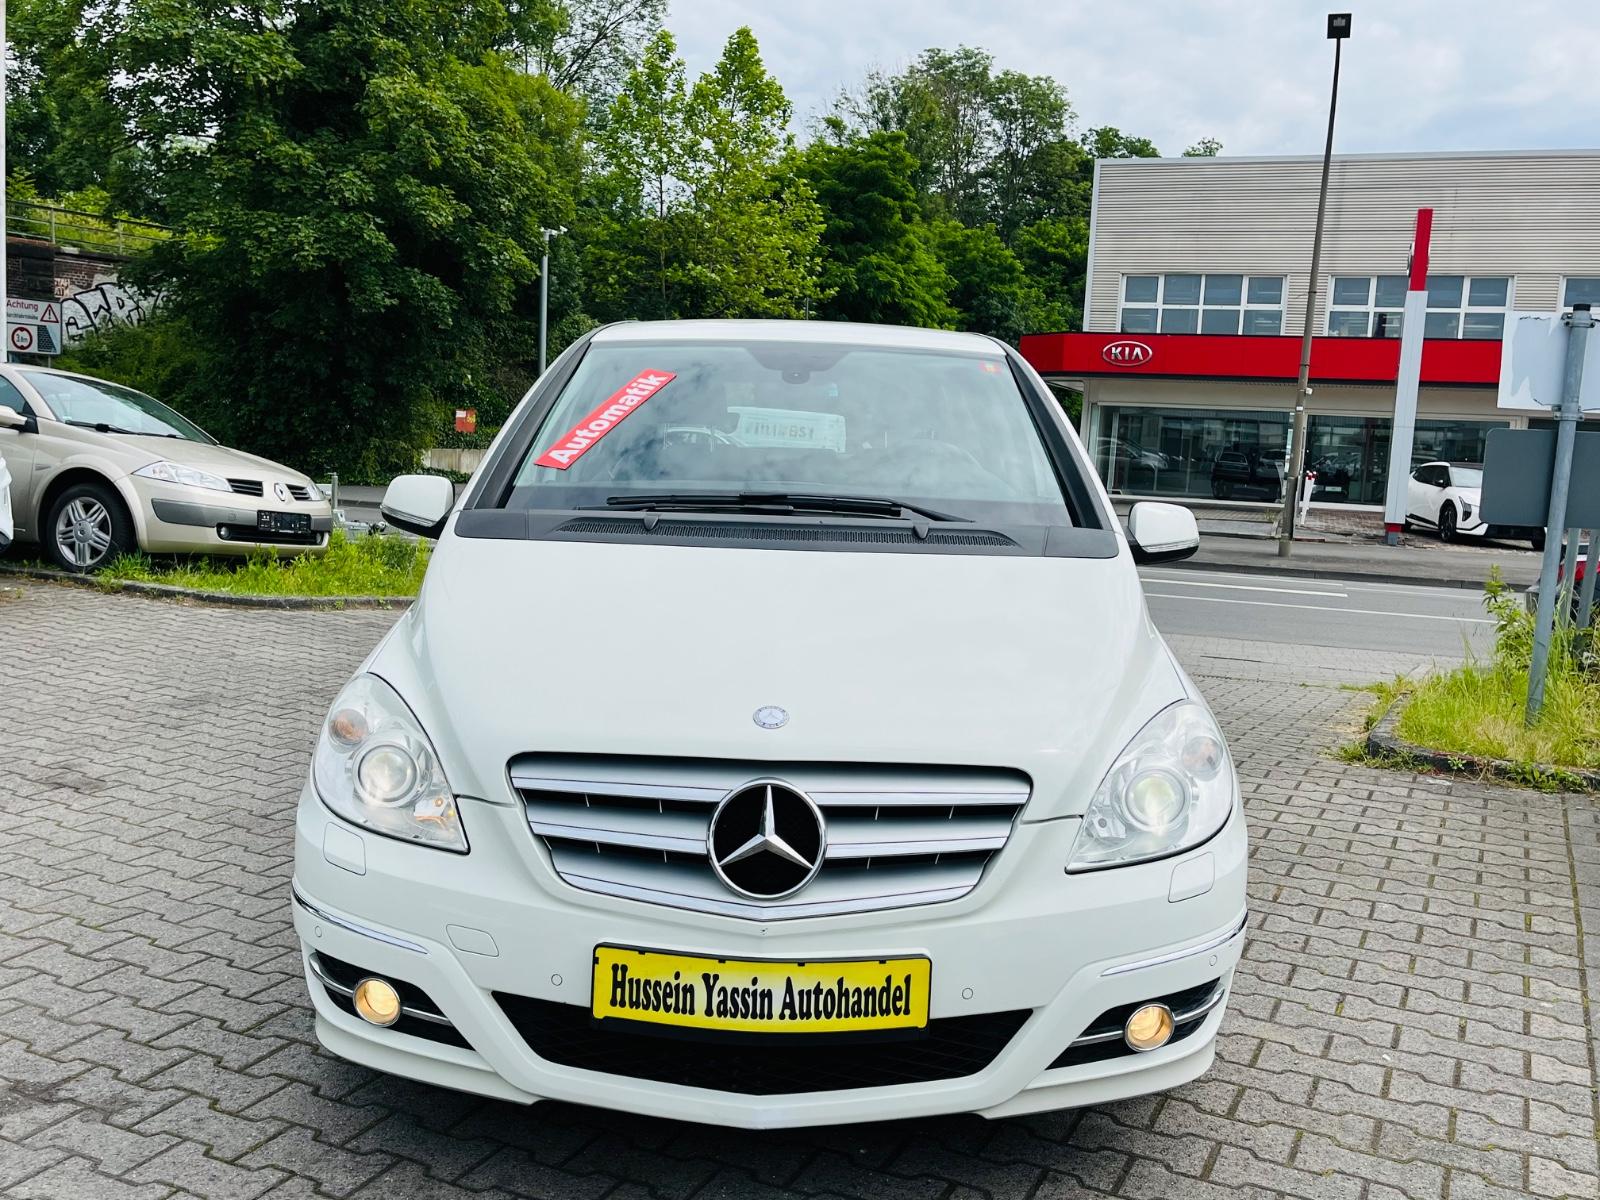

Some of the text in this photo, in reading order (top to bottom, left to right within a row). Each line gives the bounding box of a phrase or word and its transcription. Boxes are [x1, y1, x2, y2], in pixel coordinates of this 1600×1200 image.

[7, 299, 39, 312] Achtung
[1111, 346, 1144, 361] KIA
[550, 374, 667, 464] Automatik
[610, 963, 912, 1021] Hussein Yassin Autohandel
